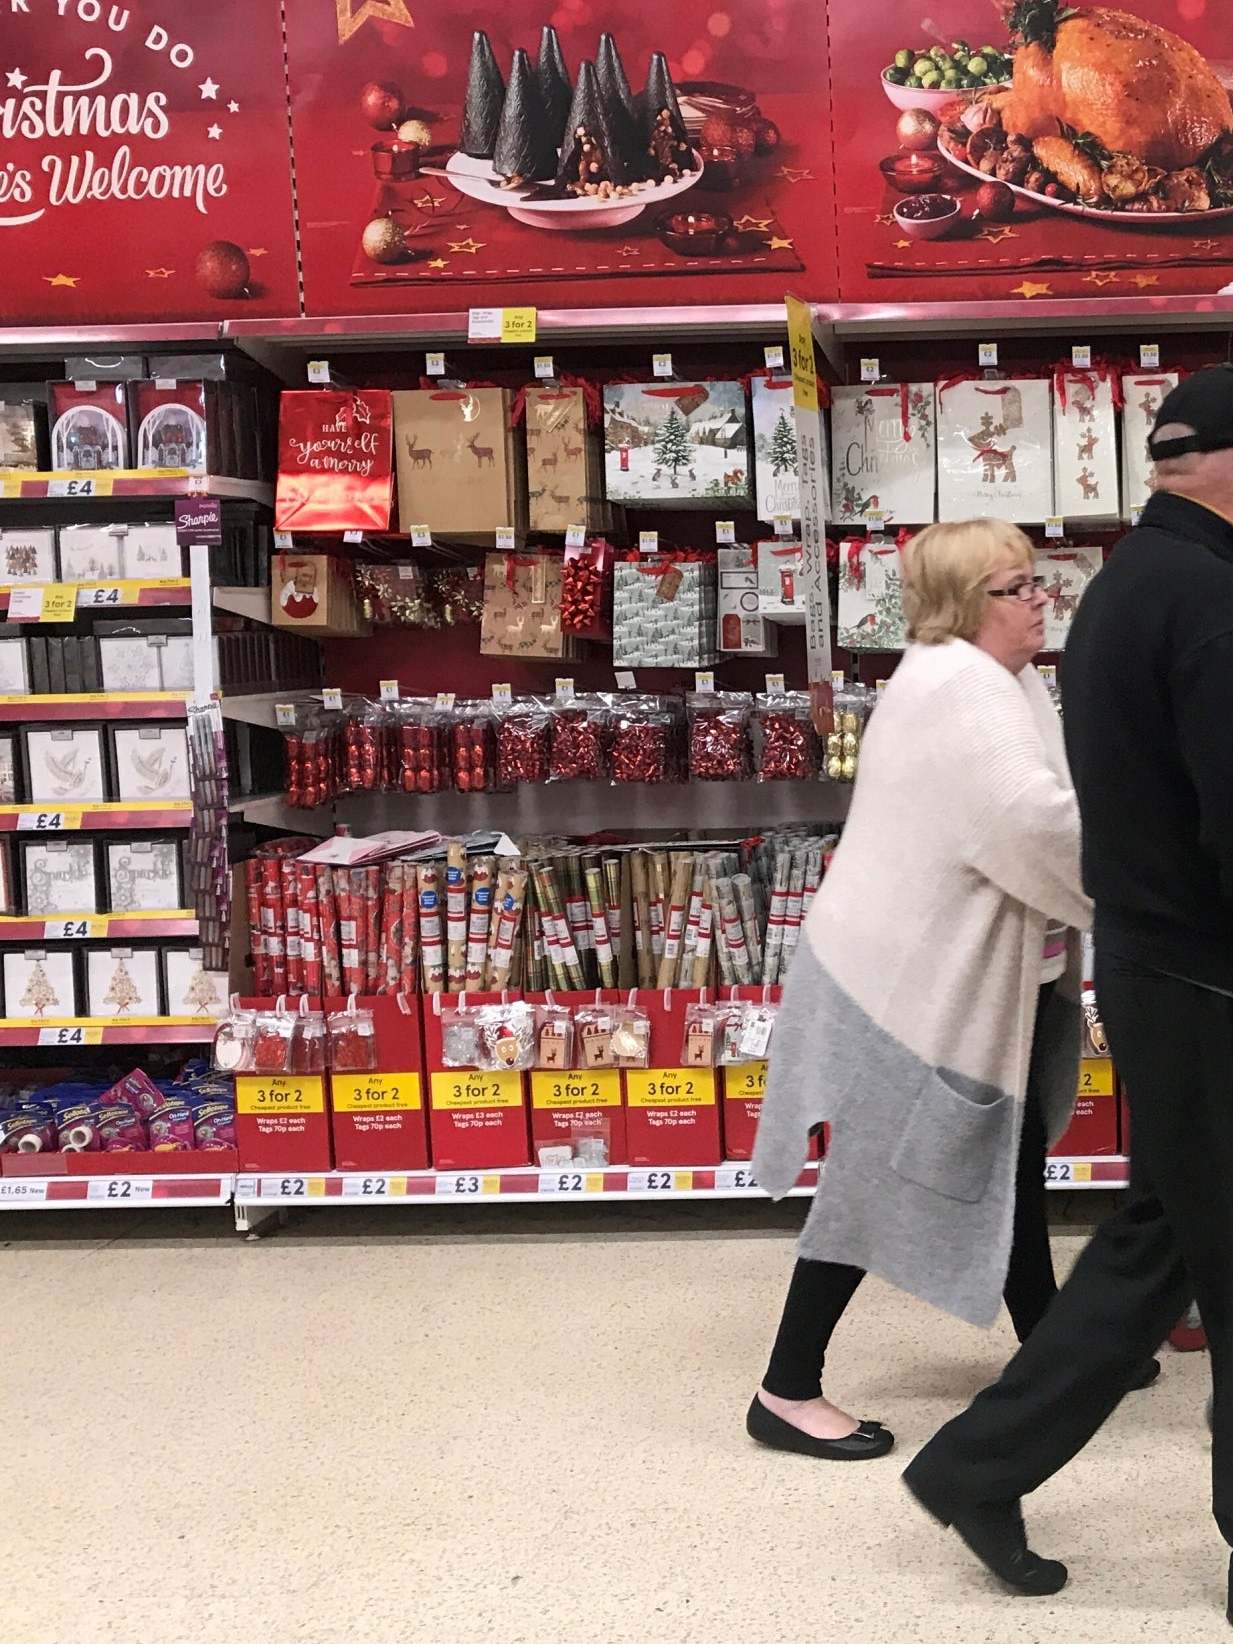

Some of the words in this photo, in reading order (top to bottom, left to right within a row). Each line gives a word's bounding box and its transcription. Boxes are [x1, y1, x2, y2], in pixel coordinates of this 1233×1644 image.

[144, 24, 194, 68] DO
[41, 145, 228, 214] Welcome
[322, 424, 347, 432] HAVE
[289, 432, 379, 464] yourself
[310, 458, 321, 469] a
[67, 480, 92, 495] £4
[177, 511, 218, 529] Sharpie
[808, 437, 822, 592] Accessories
[93, 588, 119, 604] £4
[66, 600, 72, 608] 2
[815, 601, 824, 649] and
[36, 814, 61, 829] £4
[63, 921, 88, 937] £4
[57, 1028, 82, 1044] £4
[271, 1078, 286, 1087] Any
[468, 1073, 484, 1082] Any
[662, 1071, 677, 1080] Any
[257, 1090, 266, 1102] 3
[268, 1090, 291, 1103] for
[294, 1089, 302, 1102] 2
[353, 1088, 362, 1100] 3
[365, 1088, 387, 1100] for
[391, 1087, 400, 1100] 2
[453, 1085, 462, 1097] 3
[465, 1085, 487, 1097] for
[491, 1084, 501, 1096] 2
[553, 1085, 562, 1097] 3
[565, 1084, 587, 1097] for
[591, 1083, 600, 1096] 2
[648, 1083, 656, 1095] 3
[659, 1083, 681, 1095] for
[686, 1082, 694, 1094] 2
[646, 1110, 668, 1119] Wraps
[679, 1109, 697, 1117] each
[648, 1118, 663, 1127] Tags
[664, 1117, 678, 1126] 70p
[678, 1117, 696, 1125] each
[1046, 1164, 1070, 1180] £2
[280, 1179, 304, 1195] £2
[362, 1178, 386, 1194] £2
[455, 1177, 479, 1193] £3
[558, 1174, 582, 1190] £2
[647, 1173, 671, 1189] £2
[1, 1186, 28, 1194] £1.65
[107, 1181, 131, 1198] £2
